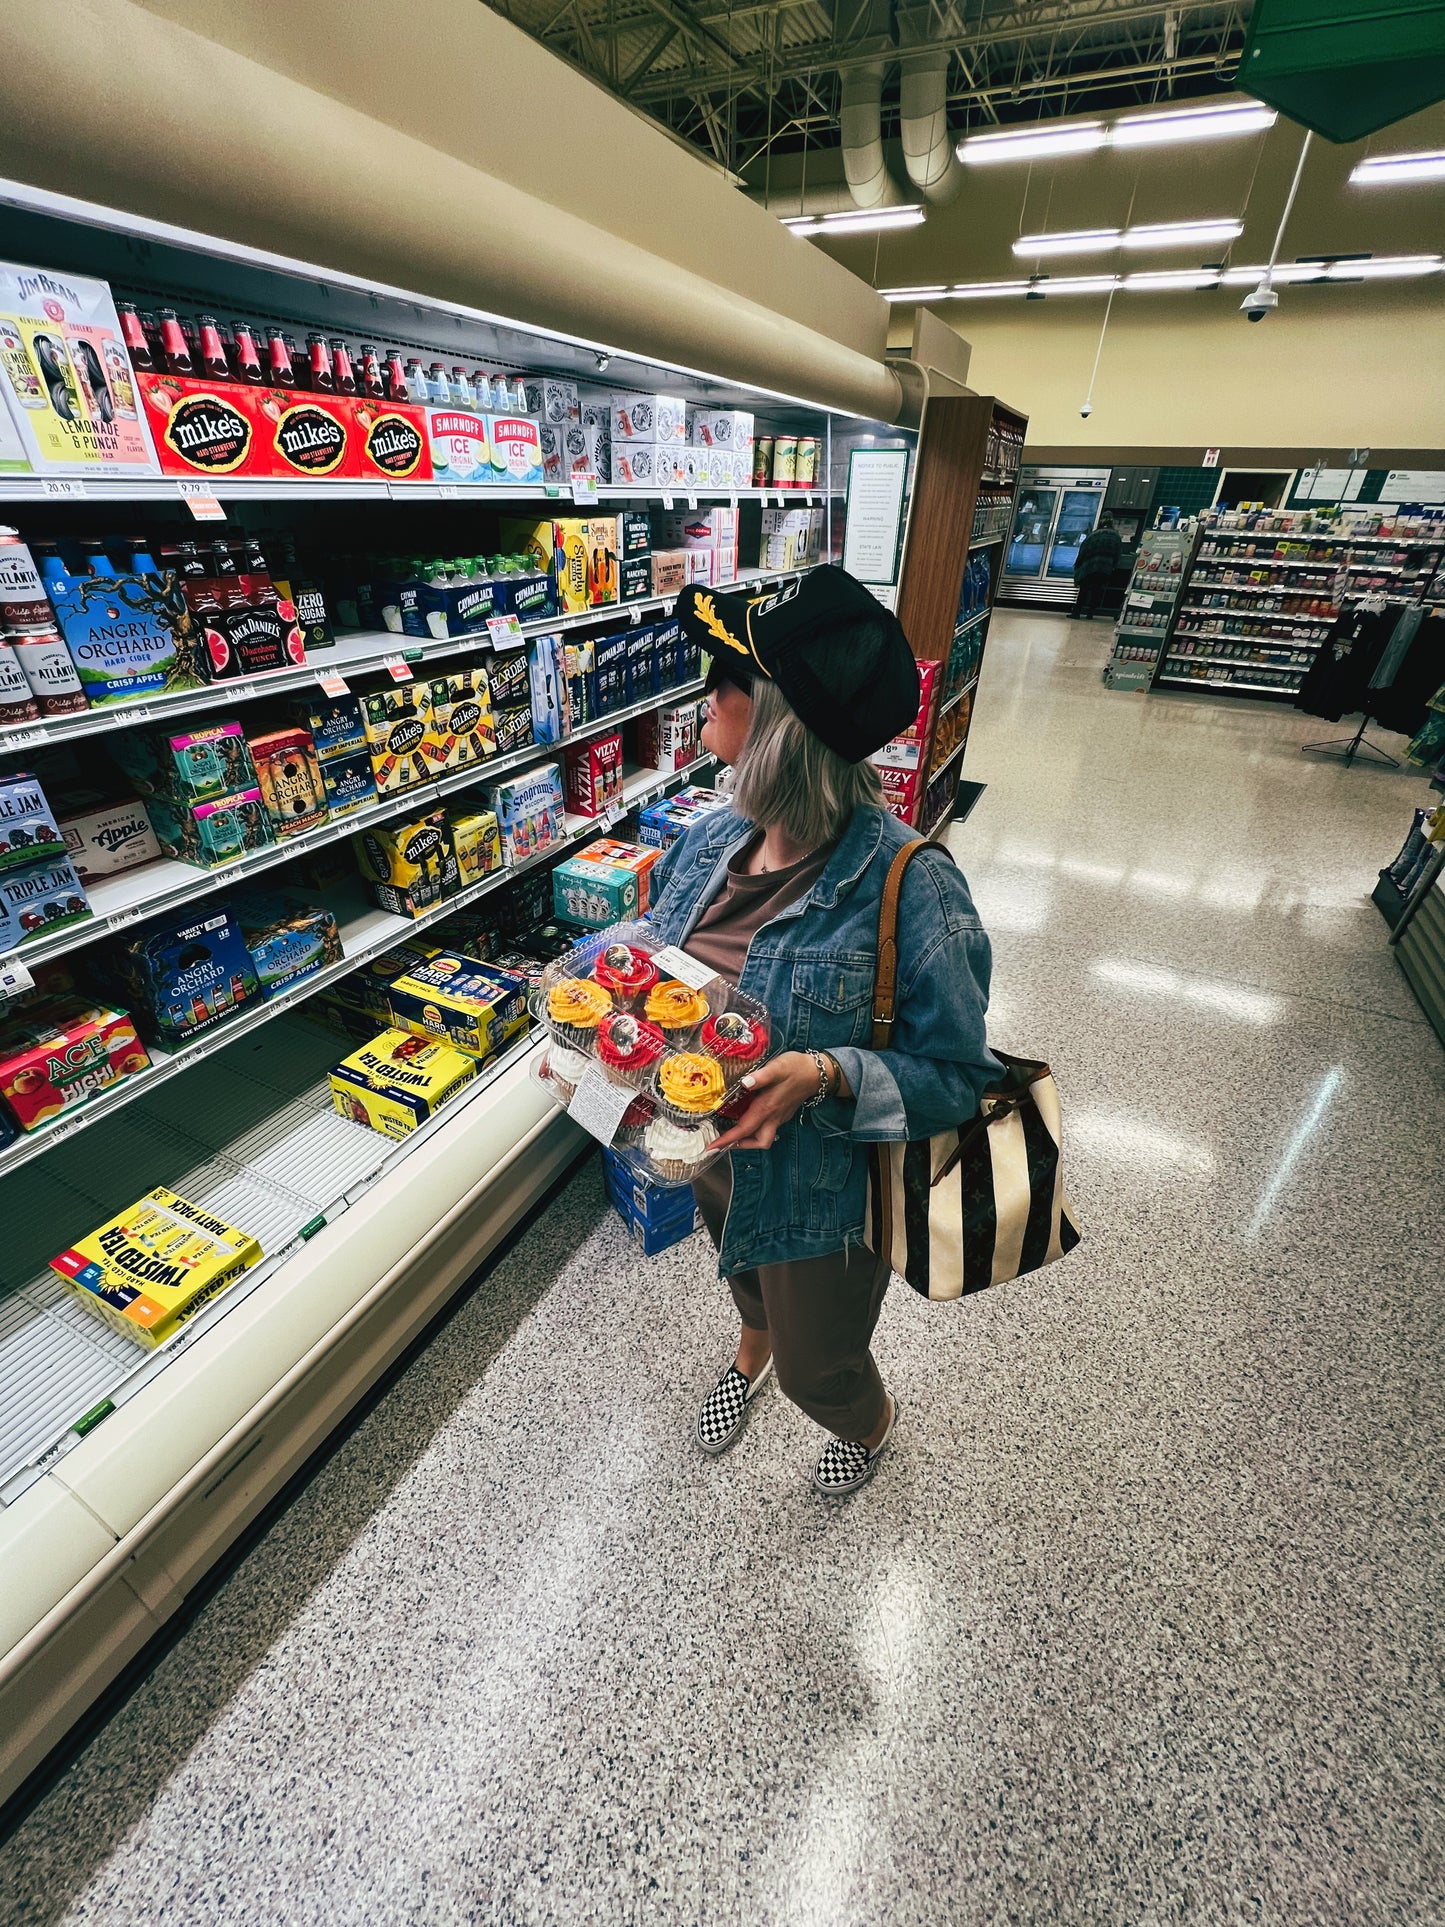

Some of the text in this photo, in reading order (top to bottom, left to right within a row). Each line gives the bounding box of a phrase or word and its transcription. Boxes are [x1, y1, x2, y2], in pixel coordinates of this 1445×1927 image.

[18, 273, 83, 310] JIM BEAM
[61, 420, 121, 437] LEMONADE
[175, 414, 244, 449] mike's
[436, 417, 480, 435] SMIRNOFF
[498, 424, 534, 440] SMIRNOFF
[74, 436, 119, 451] & PUNCH
[209, 440, 239, 455] STRAWBERRY
[282, 421, 342, 454] mike's
[371, 429, 418, 458] mike's
[449, 438, 470, 454] ICE
[311, 446, 336, 459] STRAWBERRY
[450, 455, 474, 465] ORIGINAL
[508, 443, 526, 457] ICE
[595, 437, 605, 463] WHITE
[47, 482, 72, 494] 20.19
[181, 484, 201, 493] 9.79
[573, 544, 586, 595] Simply
[297, 592, 324, 610] ZERO
[400, 589, 418, 601] CAYMAN
[403, 596, 416, 607] JACK
[457, 586, 494, 615] CAYMAN JACK
[515, 580, 549, 606] CAYMAN JACK
[4, 604, 31, 616] Crisp
[299, 606, 327, 622] SUGAR
[461, 600, 494, 622] MARGARITA
[88, 622, 148, 642] ANGRY
[229, 618, 281, 645] JACK DANIEL'S
[655, 631, 673, 649] CAYMAN
[77, 635, 166, 660] ORCHARD
[598, 640, 627, 667] CAYMAN JACK
[627, 637, 646, 657] CAYMAN
[104, 653, 151, 668] HARD CIDER
[250, 654, 277, 664] PUNCH
[106, 673, 164, 689] CRISP APPLE
[489, 655, 529, 692] HARDER
[1115, 670, 1145, 682] spindrift
[46, 697, 73, 709] Crisp
[326, 715, 348, 729] ANGRY
[450, 705, 481, 733] mike's
[495, 708, 533, 745] HARDER
[680, 709, 695, 724] TRULY
[188, 727, 227, 742] TROPICAL
[322, 721, 355, 736] ORCHARD
[390, 722, 425, 750] mike's
[321, 736, 363, 756] CRISP IMPERIAL
[594, 741, 620, 760] VIZZY
[663, 725, 672, 757] TRULY
[190, 765, 218, 775] ORCHARD
[193, 761, 211, 769] ANGRY
[275, 770, 309, 790] ANGRY
[336, 780, 367, 797] ORCHARD
[339, 775, 361, 789] ANGRY
[577, 751, 593, 813] VIZZY
[211, 793, 247, 809] TROPICAL
[269, 779, 318, 803] ORCHARD
[513, 781, 554, 813] Seagram's
[17, 793, 44, 814] JAM
[334, 795, 375, 814] CRISP IMPERIAL
[524, 796, 547, 811] escapes
[97, 814, 136, 830] AMERICAN
[280, 810, 323, 832] PEACH MANGO
[91, 820, 146, 849] Apple
[640, 825, 662, 840] SELTZER
[405, 830, 440, 862] mike's
[367, 838, 390, 880] mike's
[4, 867, 75, 903] TRIPLE JAM
[377, 885, 391, 910] SUGAR
[384, 884, 401, 914] ZERO
[177, 922, 205, 939] VARIETY
[184, 930, 202, 941] PACK
[267, 944, 312, 971] ORCHARD
[272, 939, 303, 960] ANGRY
[177, 961, 215, 986] ANGRY
[270, 959, 321, 990] CRISP APPLE
[413, 966, 453, 983] HARD
[434, 961, 457, 971] Lipton
[171, 965, 225, 998] ORCHARD
[400, 980, 420, 990] VARIETY
[410, 972, 444, 987] ICED TEA
[180, 1003, 240, 1039] THE KNOTTY BUNCH
[422, 1016, 447, 1032] HARD
[424, 1010, 441, 1020] Lipton
[46, 1034, 108, 1082] ACE
[357, 1051, 433, 1088] TWISTED TEA
[60, 1063, 115, 1103] HIGH!
[431, 1071, 475, 1113] TWISTED TEA
[378, 1113, 403, 1127] TWISTED
[168, 1199, 229, 1236] PARTY PACK
[98, 1226, 129, 1256] TEA
[234, 1238, 245, 1248] 12
[103, 1257, 146, 1287] HARD ICED TEA
[114, 1246, 191, 1287] TWISTED
[175, 1262, 247, 1323] TWISTED TEA
[37, 1445, 59, 1467] 18.99
